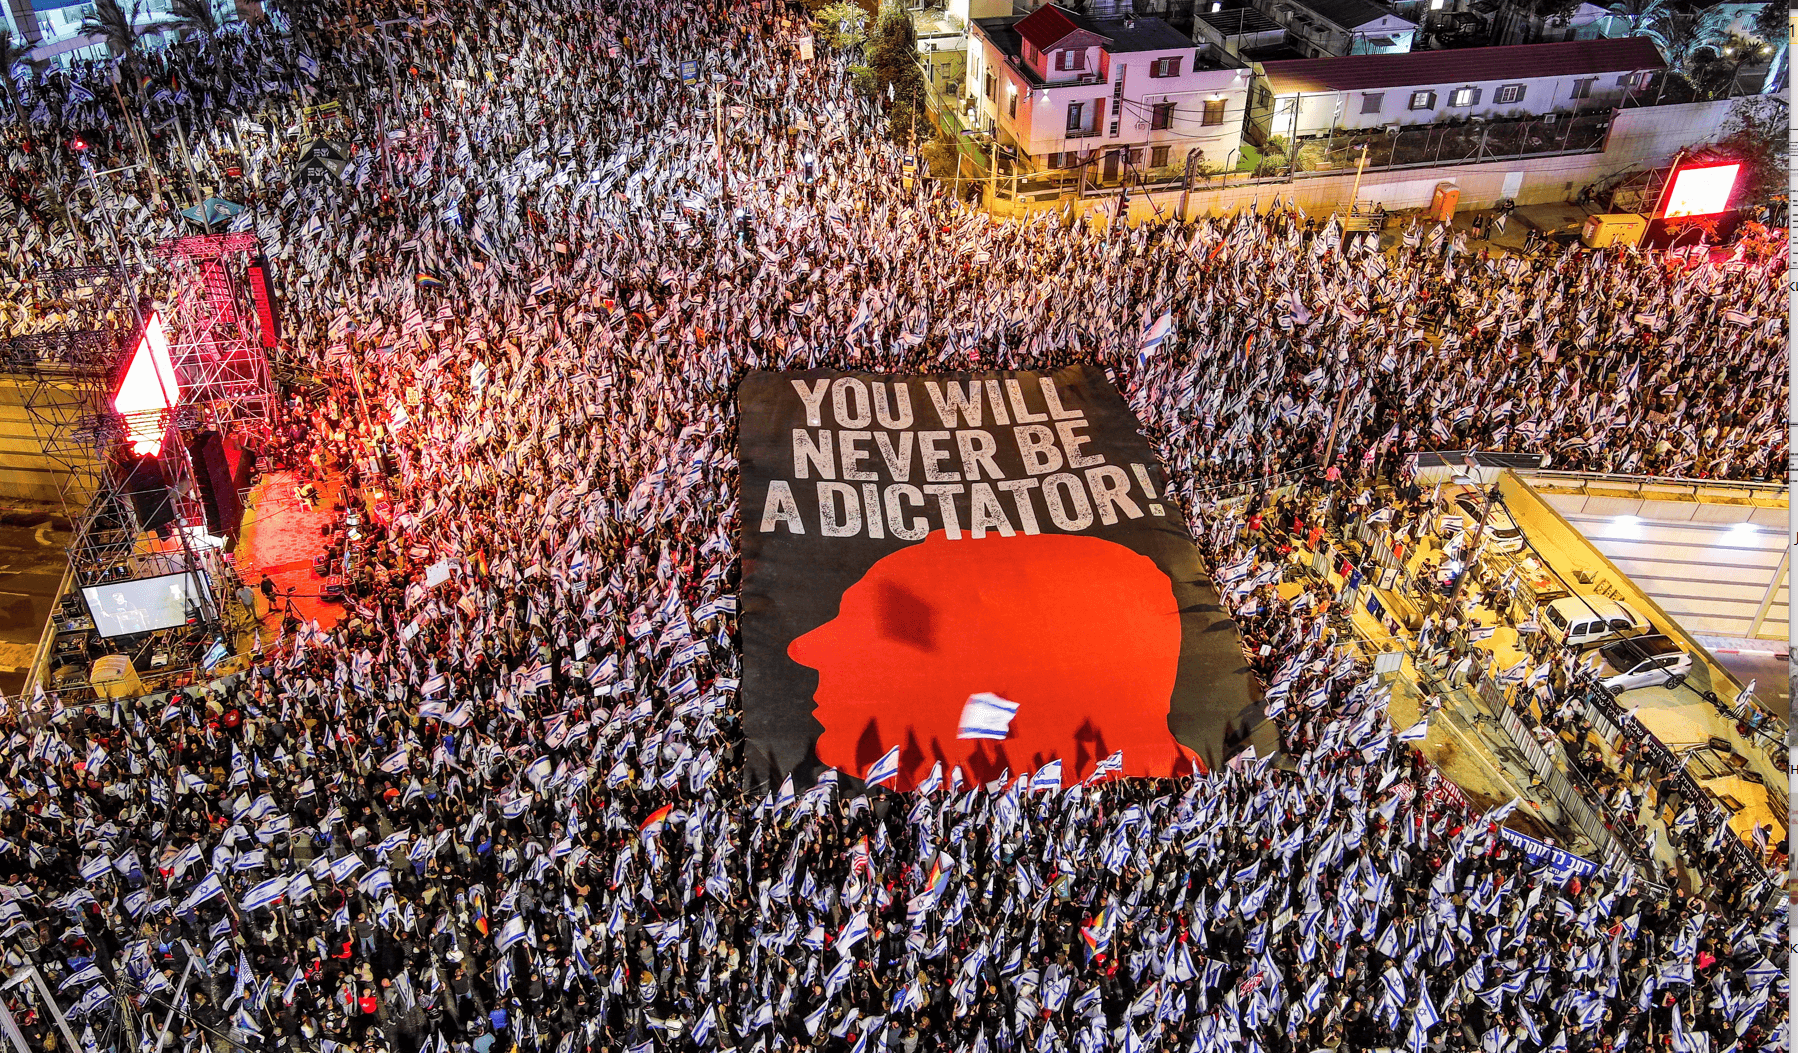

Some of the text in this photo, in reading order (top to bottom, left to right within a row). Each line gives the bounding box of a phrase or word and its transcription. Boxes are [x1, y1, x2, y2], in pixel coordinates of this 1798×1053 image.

[791, 377, 1084, 430] YOU WILL
[791, 419, 1105, 482] NEVER BE
[759, 463, 1166, 541] A DICTATOR!
[1734, 844, 1752, 866] שלום
